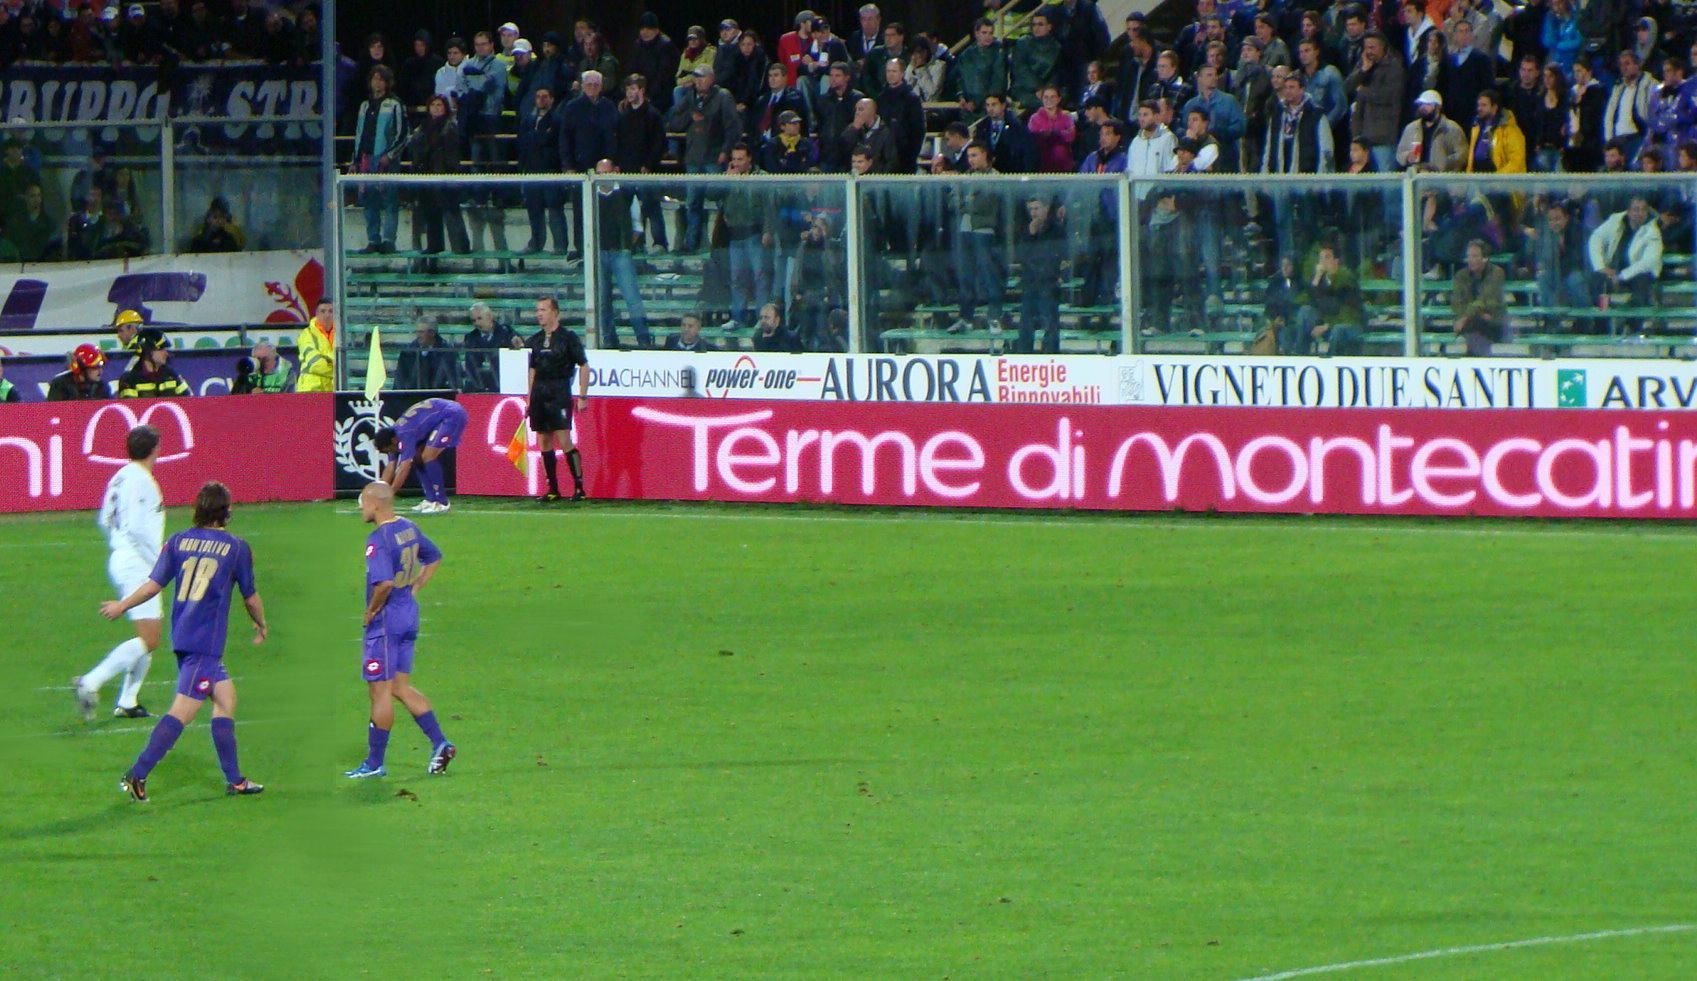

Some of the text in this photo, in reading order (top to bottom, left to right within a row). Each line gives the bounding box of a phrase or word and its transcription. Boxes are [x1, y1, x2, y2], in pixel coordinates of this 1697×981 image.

[570, 357, 798, 390] OLACHANNEL power-one
[820, 357, 992, 402] AURORA
[997, 358, 1067, 387] Energie
[1153, 363, 1537, 408] VIGNETO DUE SANTI
[630, 405, 1697, 509] Terme di montecati
[177, 555, 219, 602] 18
